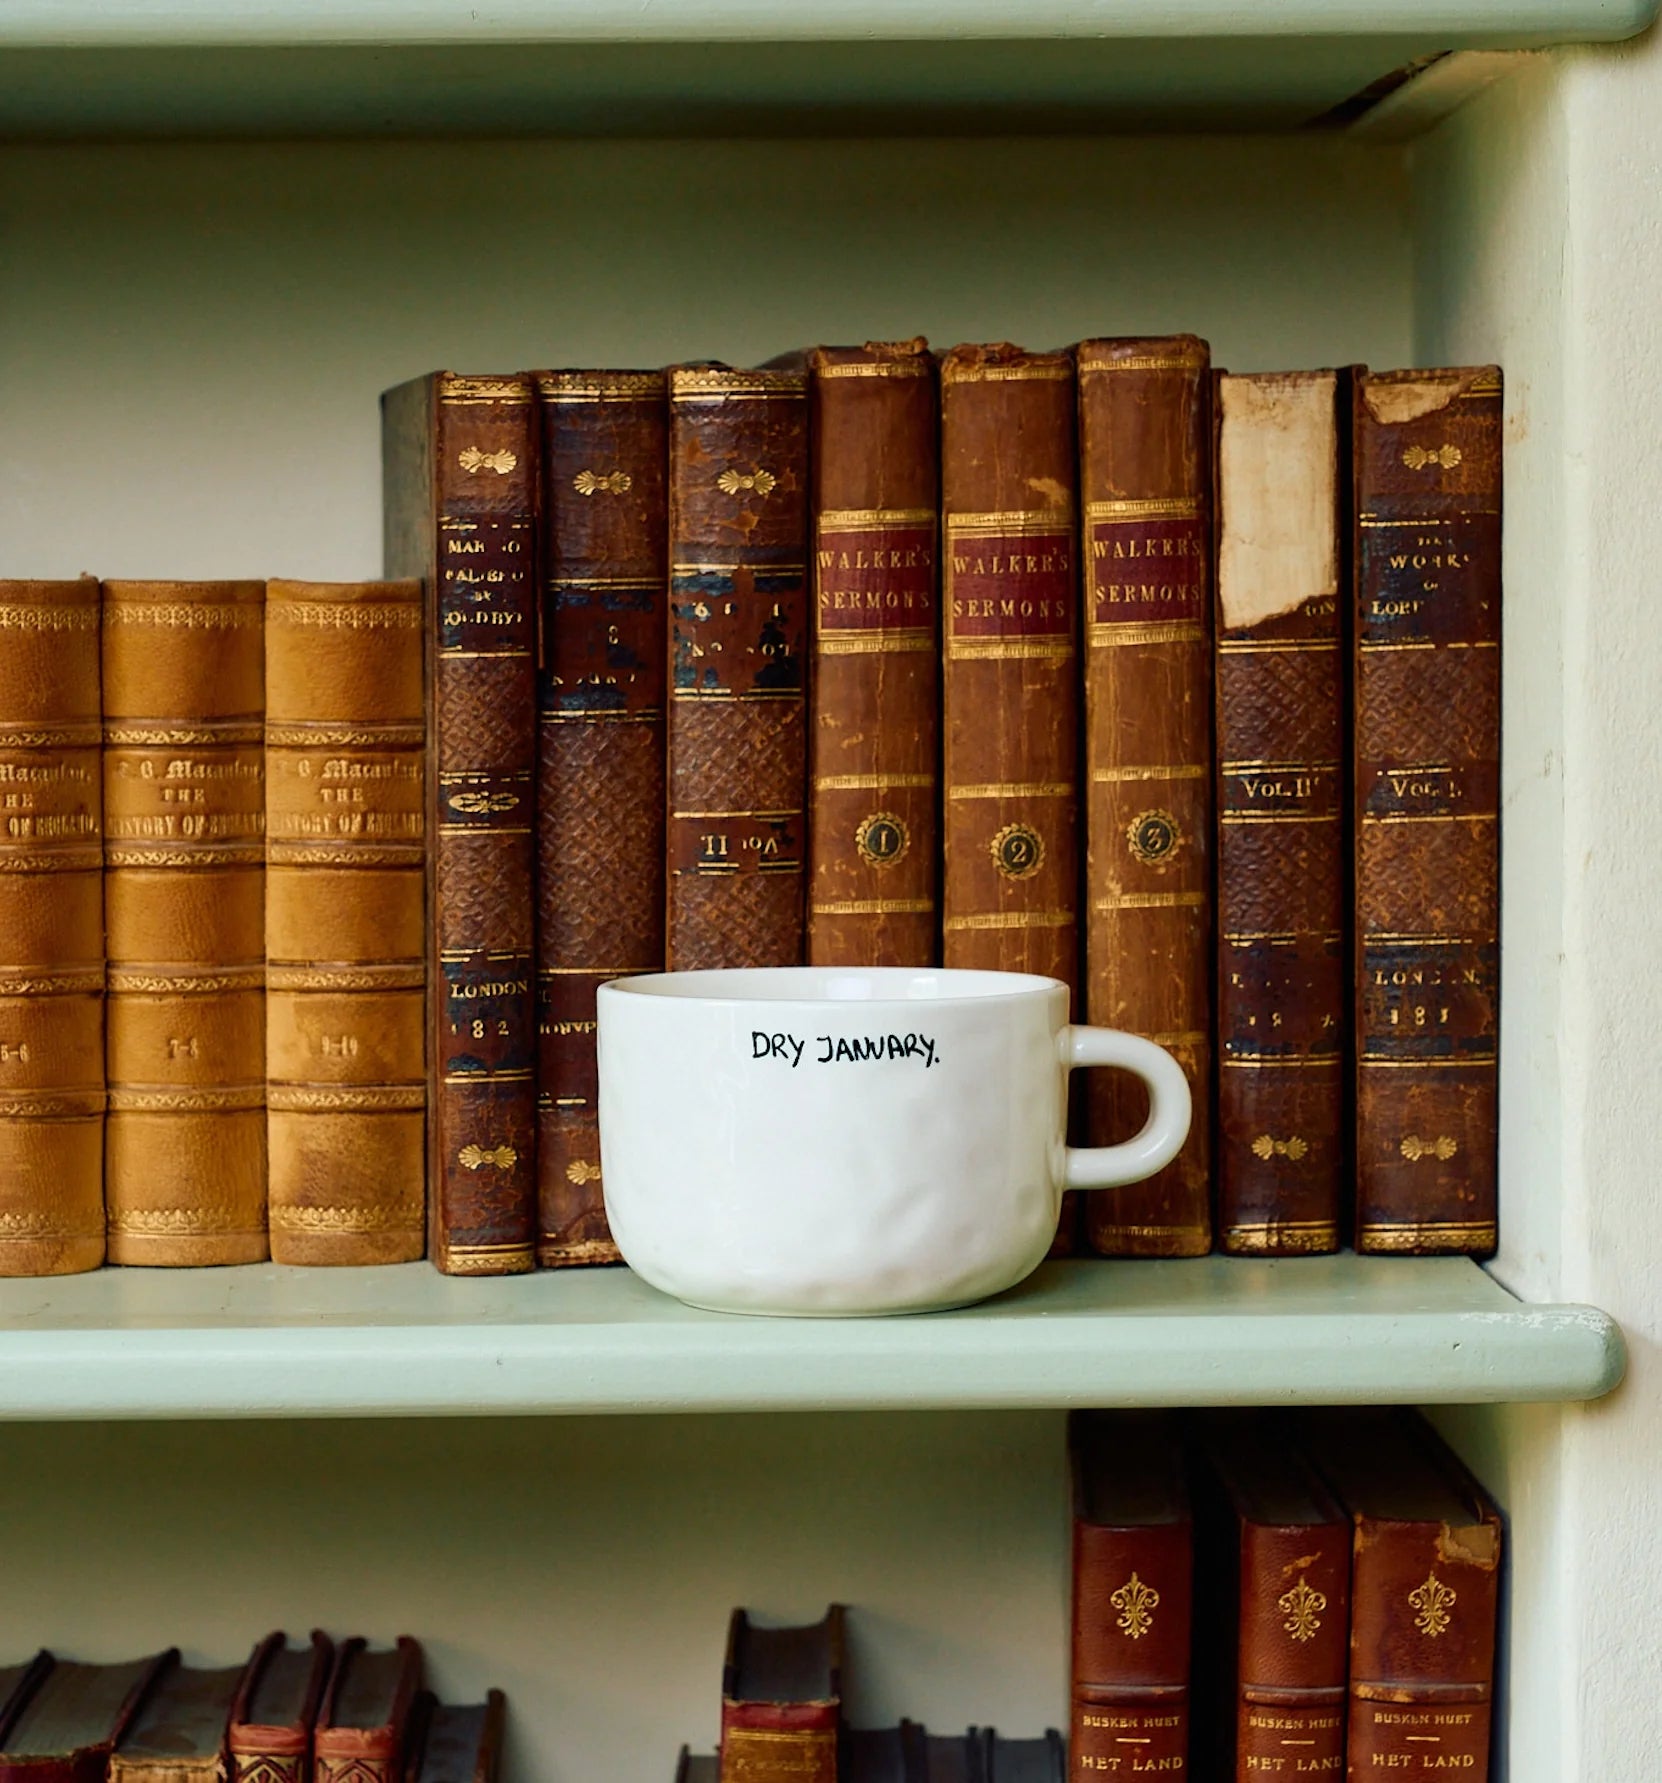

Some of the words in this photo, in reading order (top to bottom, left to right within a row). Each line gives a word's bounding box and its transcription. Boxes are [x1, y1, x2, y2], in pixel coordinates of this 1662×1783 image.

[1093, 531, 1200, 558] WALKER'S
[817, 544, 930, 569] WALKER'S
[952, 547, 1068, 574] WALKER'S
[820, 591, 929, 609] SERMONS
[1095, 584, 1199, 603] SERMONS
[953, 600, 1064, 617] SERMONS
[163, 788, 205, 803] THE
[320, 788, 364, 803] THE
[1146, 828, 1161, 850] 3
[1011, 841, 1027, 862] 2
[451, 981, 528, 998] LONDON
[752, 1031, 805, 1068] DRY
[816, 1033, 940, 1068] JANUARY.
[1083, 1715, 1138, 1728] BUSKEN
[1143, 1716, 1180, 1727] HUET
[1249, 1716, 1303, 1729] BUSKEN
[1374, 1712, 1430, 1724] BUSKEN
[1434, 1714, 1472, 1724] HUET
[1081, 1755, 1121, 1771] HET
[1132, 1757, 1183, 1771] LAND
[1246, 1756, 1285, 1771] HET
[1297, 1756, 1342, 1771] LAND
[1372, 1753, 1412, 1767] HET
[1423, 1754, 1475, 1768] LAND
